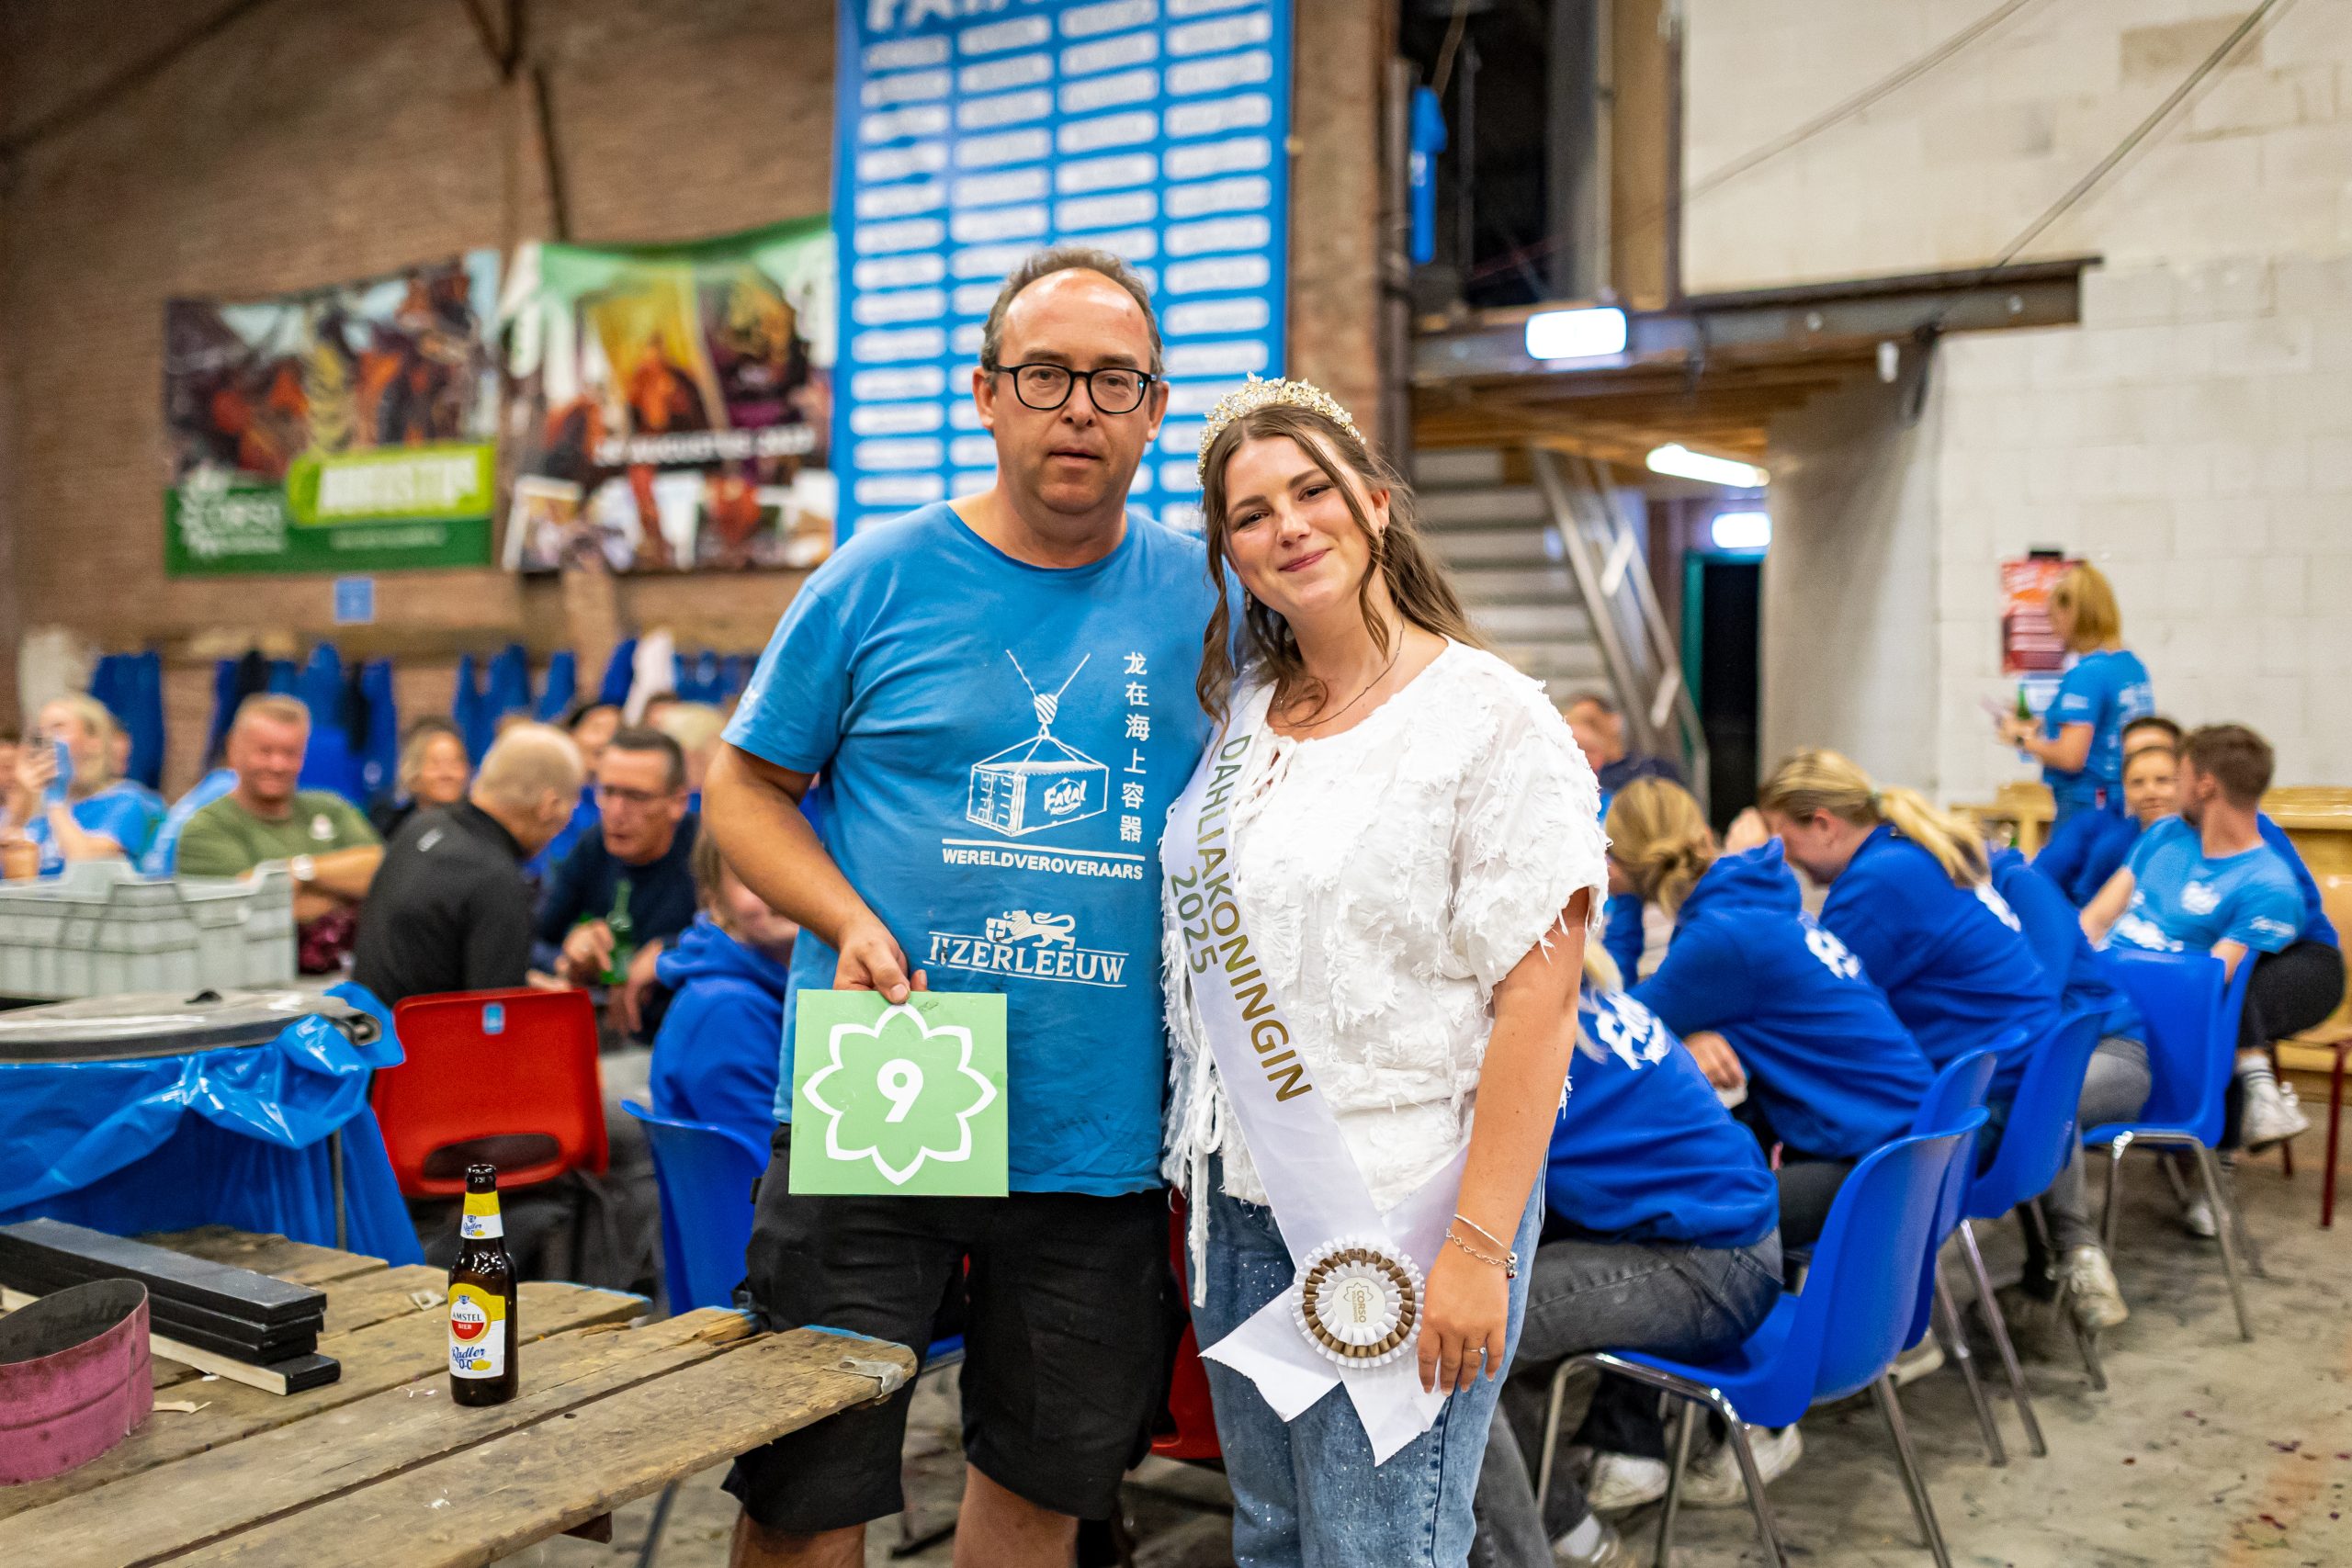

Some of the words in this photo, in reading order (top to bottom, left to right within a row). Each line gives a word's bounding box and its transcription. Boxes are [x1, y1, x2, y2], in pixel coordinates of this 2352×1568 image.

[1120, 651, 1150, 843] 龙在海上容器
[1044, 780, 1087, 812] Fatal
[942, 848, 1144, 881] WERELDVEROVERAARS
[1170, 865, 1219, 975] 2025
[1196, 734, 1313, 1103] DAHLIAKONINGIN
[876, 1058, 924, 1122] 9
[452, 1312, 482, 1322] AMSTEL
[1356, 1290, 1367, 1323] CORSO
[451, 1346, 485, 1361] Radler
